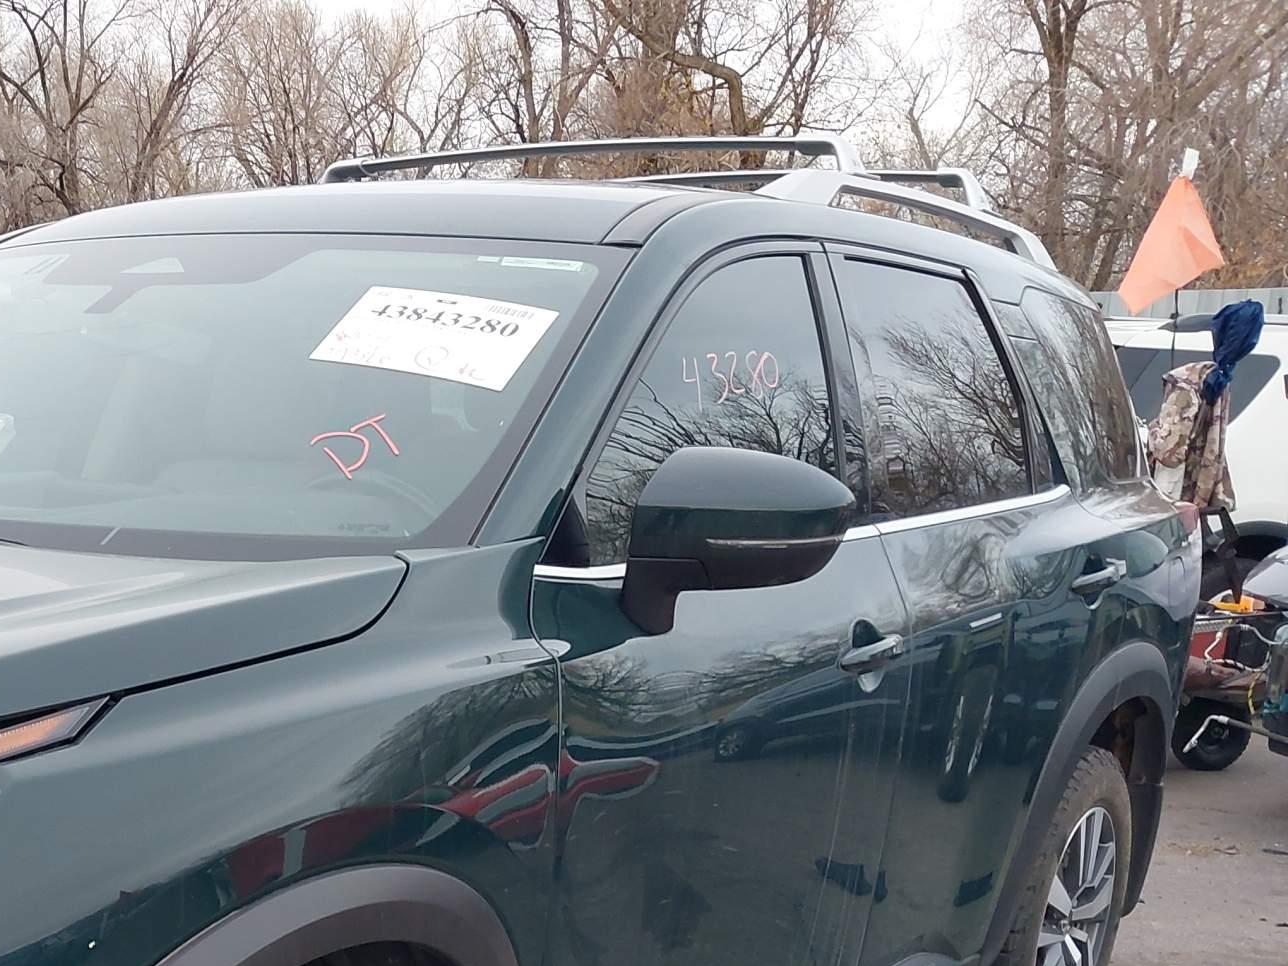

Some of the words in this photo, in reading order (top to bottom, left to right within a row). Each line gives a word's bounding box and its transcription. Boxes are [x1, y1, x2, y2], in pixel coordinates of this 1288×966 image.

[370, 303, 520, 337] 43843280
[682, 350, 779, 412] 43280
[310, 413, 401, 480] DT
